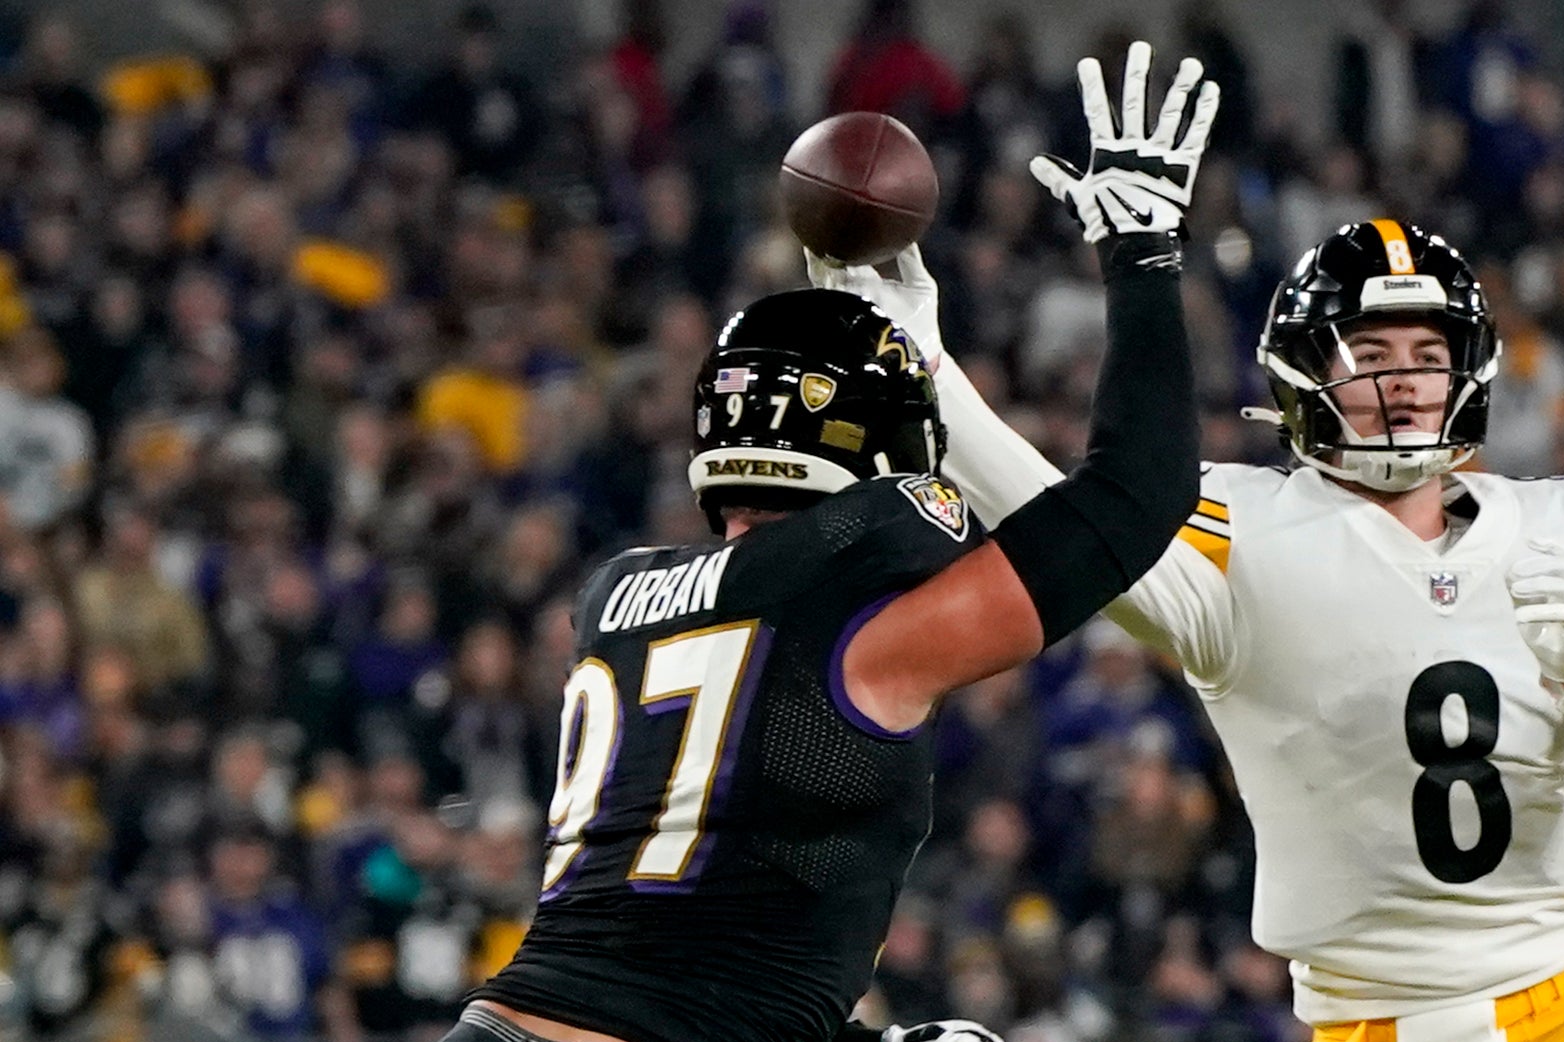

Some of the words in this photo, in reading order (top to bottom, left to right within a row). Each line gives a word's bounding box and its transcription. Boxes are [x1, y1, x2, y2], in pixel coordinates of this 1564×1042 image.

[1383, 277, 1422, 290] Steelers
[1385, 239, 1412, 272] 8
[704, 459, 808, 480] RAVENS
[599, 545, 734, 633] URBAN
[540, 618, 774, 902] 97
[1404, 660, 1512, 884] 8
